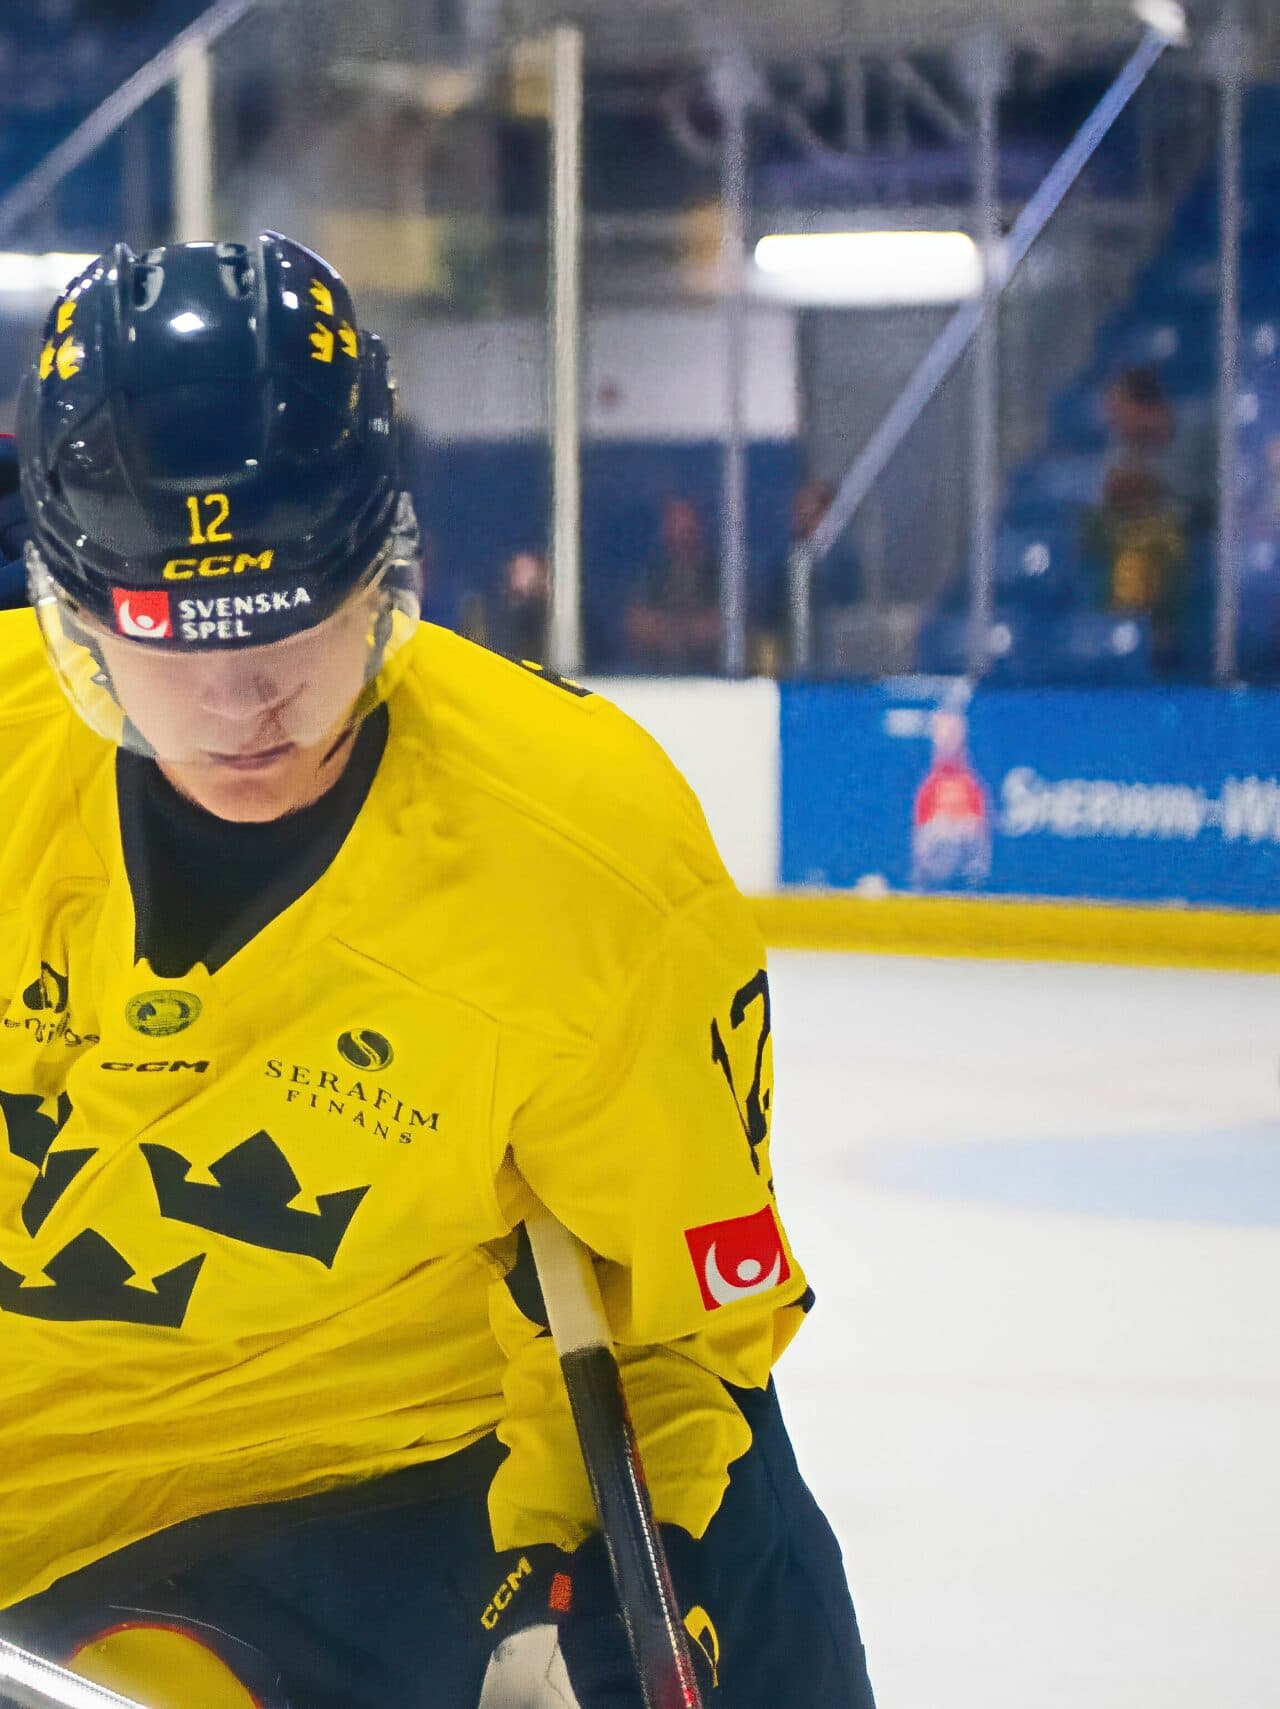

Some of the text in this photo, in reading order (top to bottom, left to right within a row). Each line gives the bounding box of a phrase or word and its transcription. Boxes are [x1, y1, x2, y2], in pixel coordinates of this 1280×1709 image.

[186, 493, 233, 545] 12
[162, 549, 275, 581] CCM
[177, 586, 312, 620] SVENSKA
[179, 620, 252, 641] SPEL
[100, 1060, 210, 1074] CCM
[264, 1059, 440, 1132] SERAFIM
[286, 1089, 413, 1144] FINANS
[480, 1545, 534, 1631] CCM
